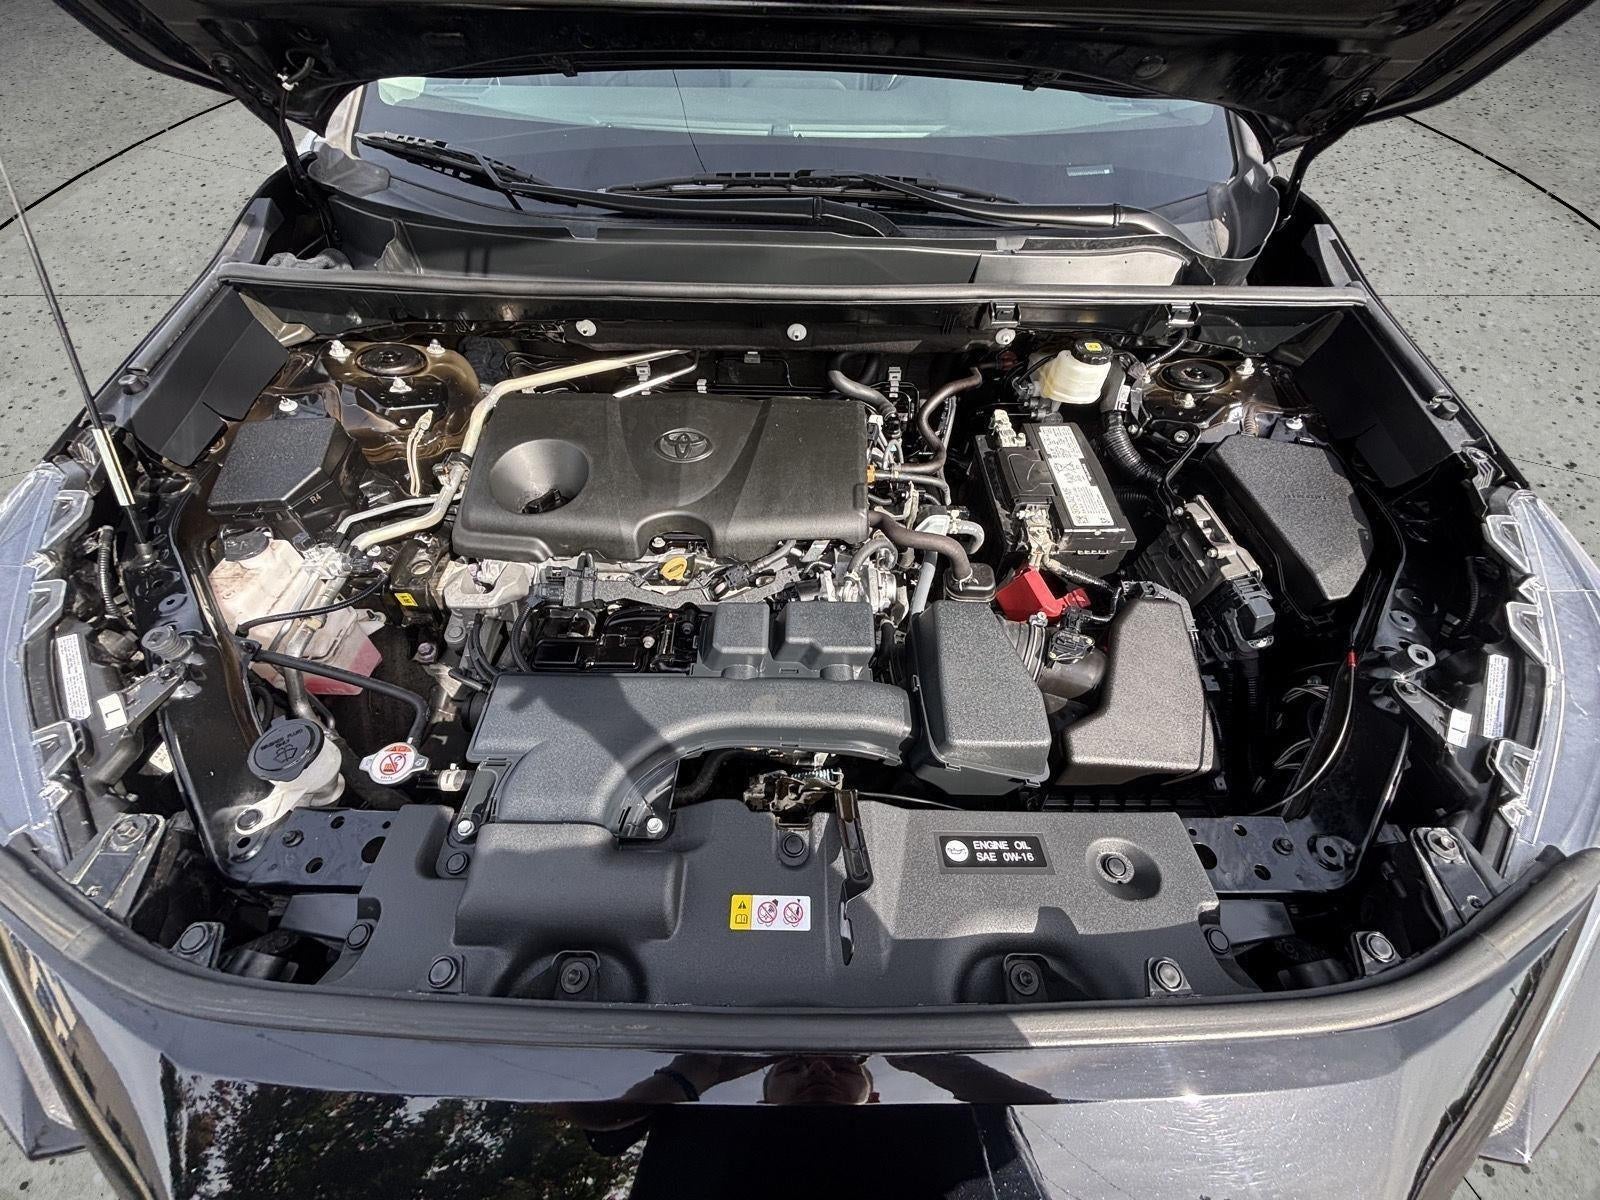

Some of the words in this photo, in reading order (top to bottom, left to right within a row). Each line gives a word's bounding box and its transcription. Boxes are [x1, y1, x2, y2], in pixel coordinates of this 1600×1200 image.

[972, 840, 1010, 850] ENGINE
[1013, 840, 1032, 850] OIL
[976, 852, 998, 862] SAE
[1002, 852, 1035, 862] 0W-16
